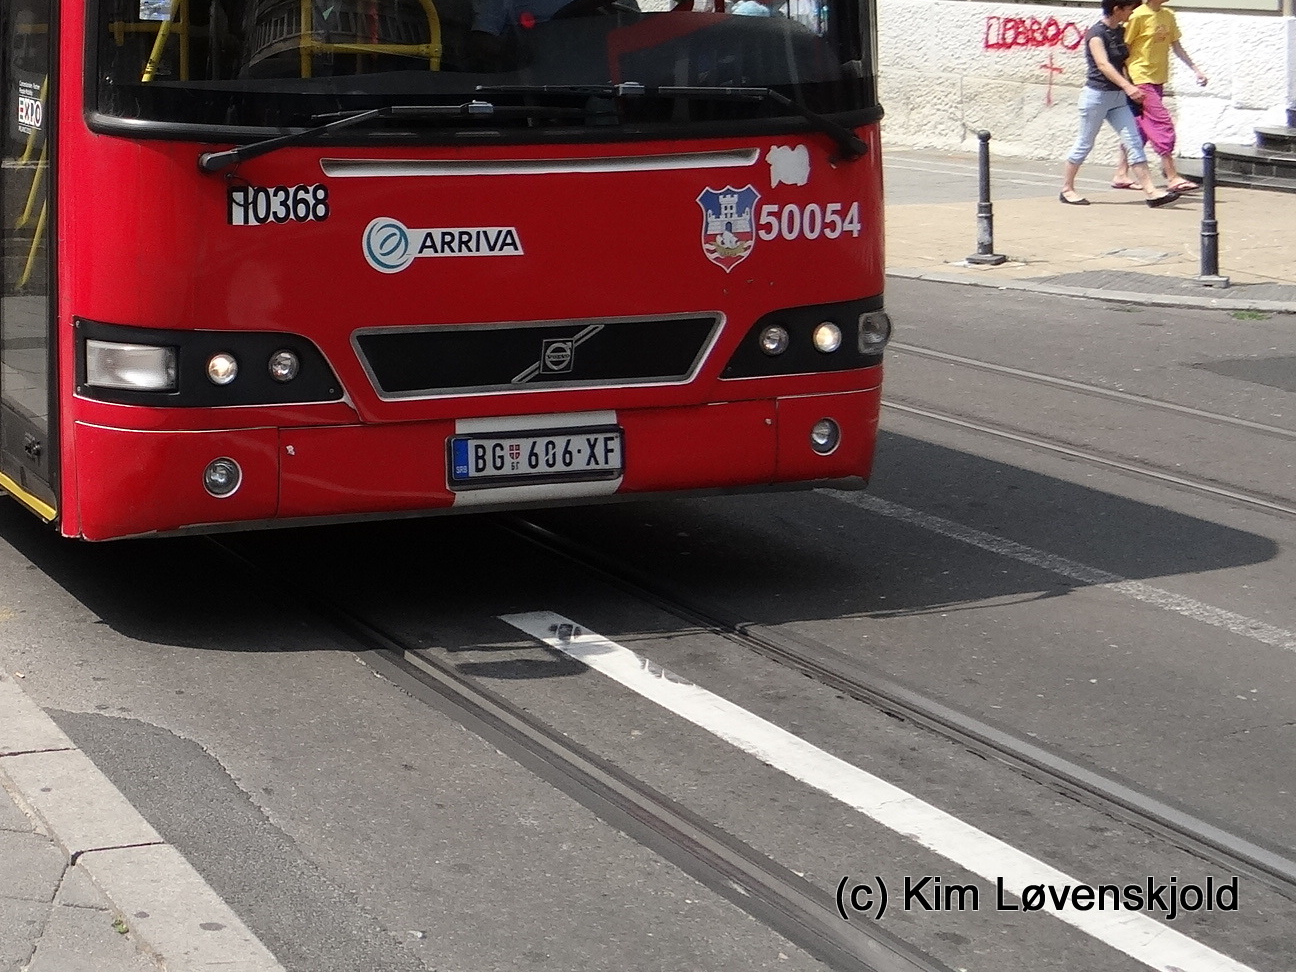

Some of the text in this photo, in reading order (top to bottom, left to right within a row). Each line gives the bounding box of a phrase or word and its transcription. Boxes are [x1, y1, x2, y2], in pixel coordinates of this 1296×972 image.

[758, 201, 861, 241] 50054
[417, 229, 519, 254] ARRIVA
[474, 443, 504, 473] BG
